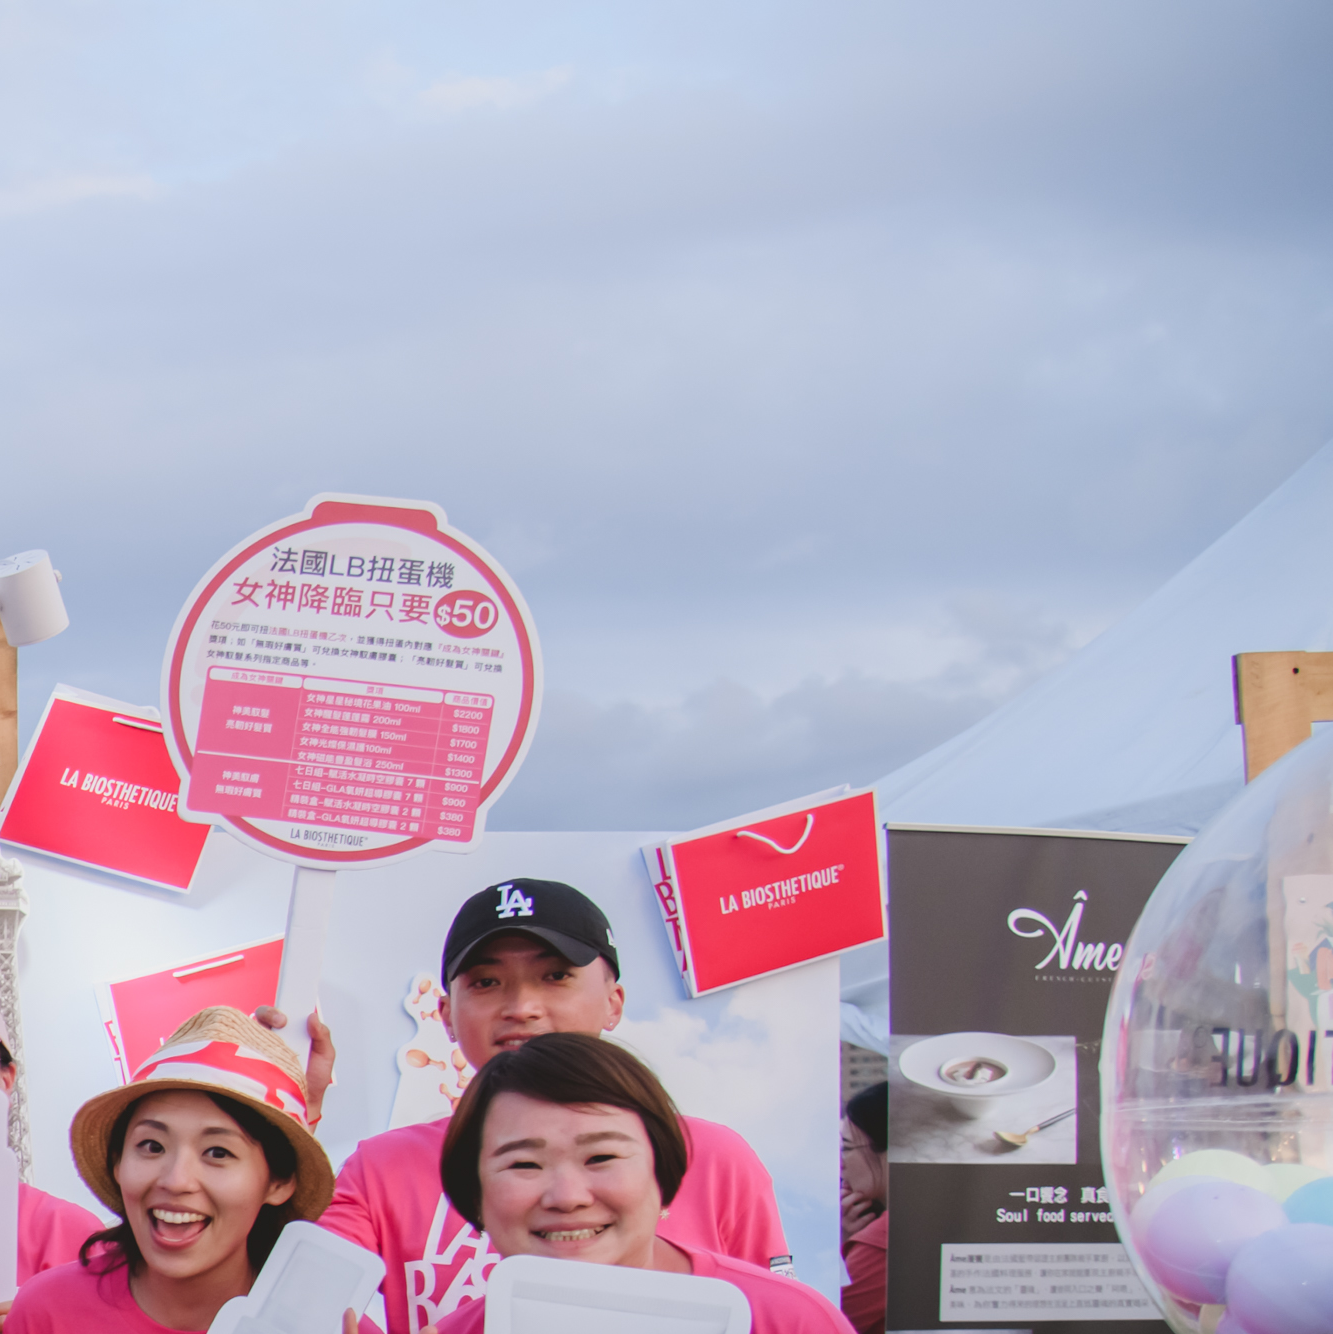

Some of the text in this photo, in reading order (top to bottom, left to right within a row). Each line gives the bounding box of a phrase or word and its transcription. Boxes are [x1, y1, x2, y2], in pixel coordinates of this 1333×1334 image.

[270, 547, 456, 589] 法國LB扭蛋機
[231, 577, 495, 629] 女神降臨只要 $50
[394, 703, 483, 720] 100ml $2200
[373, 716, 479, 735] 200ml $1800
[380, 730, 477, 749] 150ml $1700
[447, 754, 475, 764] $1400
[375, 760, 472, 779] 250ml $1300
[60, 768, 81, 789] LA
[444, 783, 468, 793] $900
[101, 798, 129, 811] PARIS
[442, 797, 466, 807] $900
[440, 812, 463, 822] $380
[290, 828, 302, 840] LA
[437, 826, 461, 837] $380
[495, 884, 533, 919] LA
[720, 894, 739, 915] LA
[768, 896, 796, 910] PARIS
[996, 1208, 1065, 1223] Soul food
